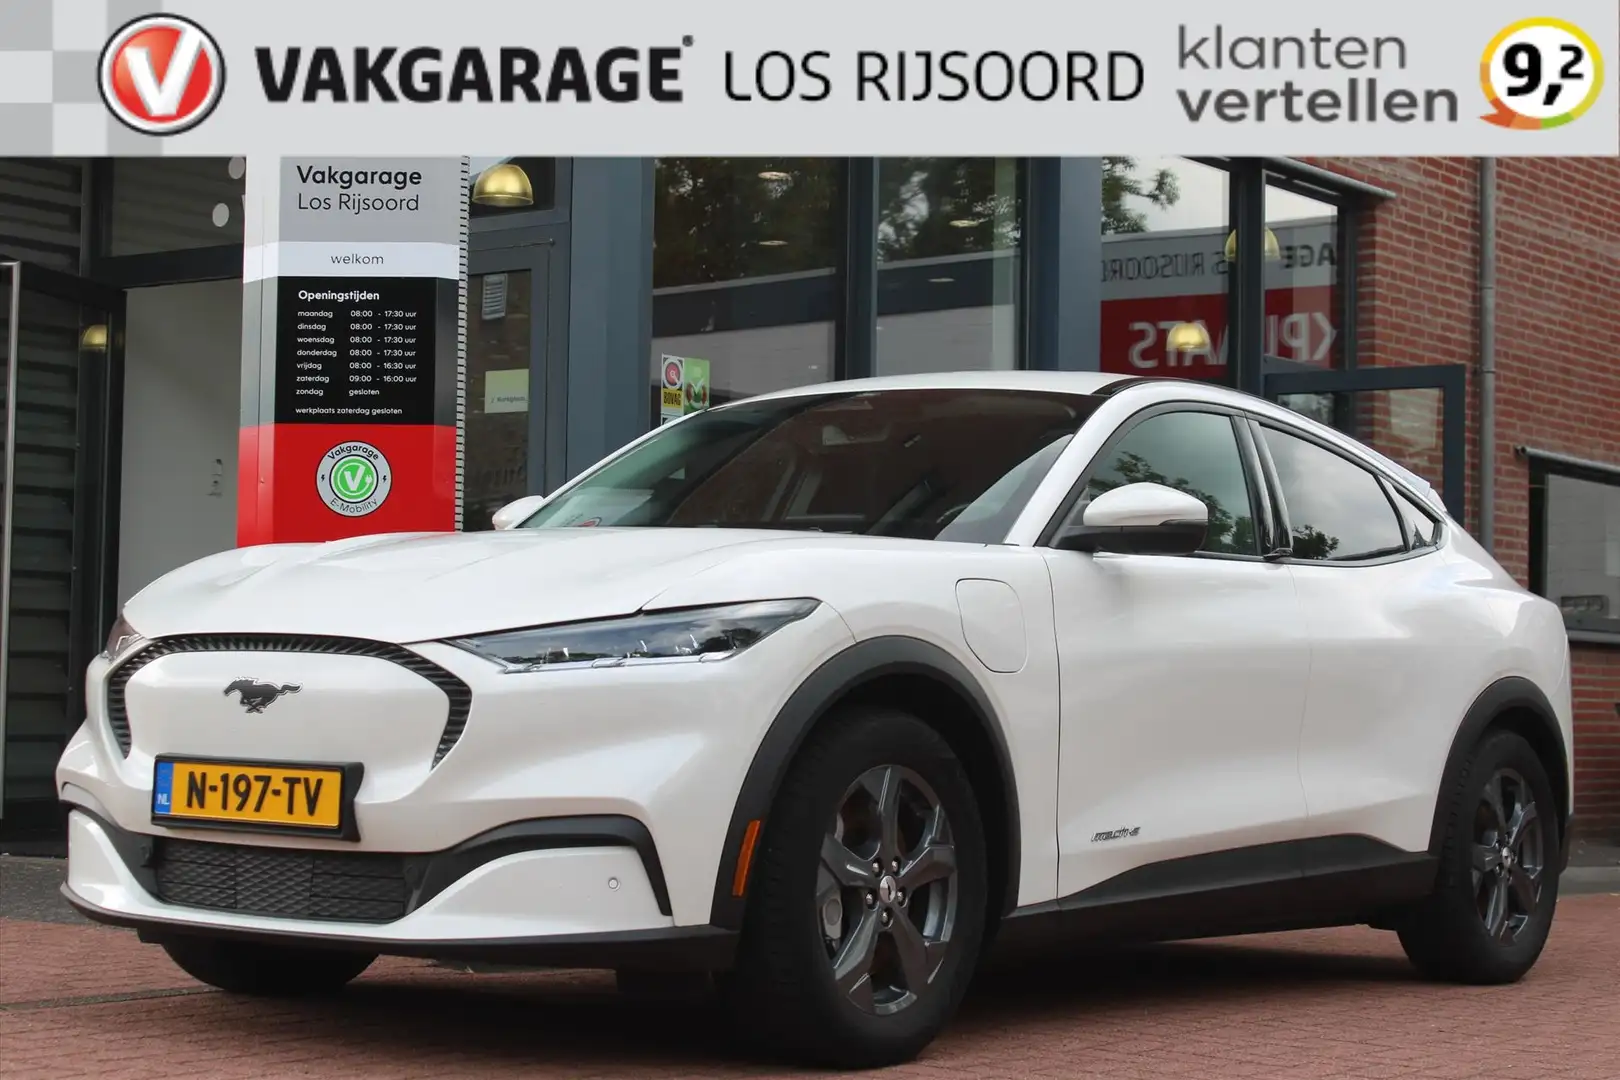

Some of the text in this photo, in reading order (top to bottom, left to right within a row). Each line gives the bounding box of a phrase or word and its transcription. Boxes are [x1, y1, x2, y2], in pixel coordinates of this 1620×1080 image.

[296, 165, 422, 190] Vakgarage
[298, 193, 419, 215] Los Rijsoord
[330, 253, 384, 265] welkom
[298, 289, 380, 302] Openingstijden
[297, 310, 334, 318] maandag
[384, 310, 404, 318] 17:30
[297, 323, 327, 331] dinsdag
[384, 323, 404, 331] 17:30
[297, 336, 335, 344] woensdag
[384, 336, 404, 344] 17:30
[296, 349, 338, 357] donderdag
[383, 349, 404, 357] 17:30
[296, 362, 323, 370] vrijdag
[383, 362, 404, 370] 16:30
[296, 375, 330, 383] zaterdag
[383, 375, 404, 383] 16:00
[296, 388, 380, 397] zondag gesloten
[664, 392, 681, 406] BOVAG
[295, 407, 403, 416] werkplaats zaterdag gesloten
[327, 444, 379, 460] Vakgarage
[329, 498, 377, 513] E-Mobility
[157, 793, 170, 805] NL
[186, 771, 323, 817] N-197-TV
